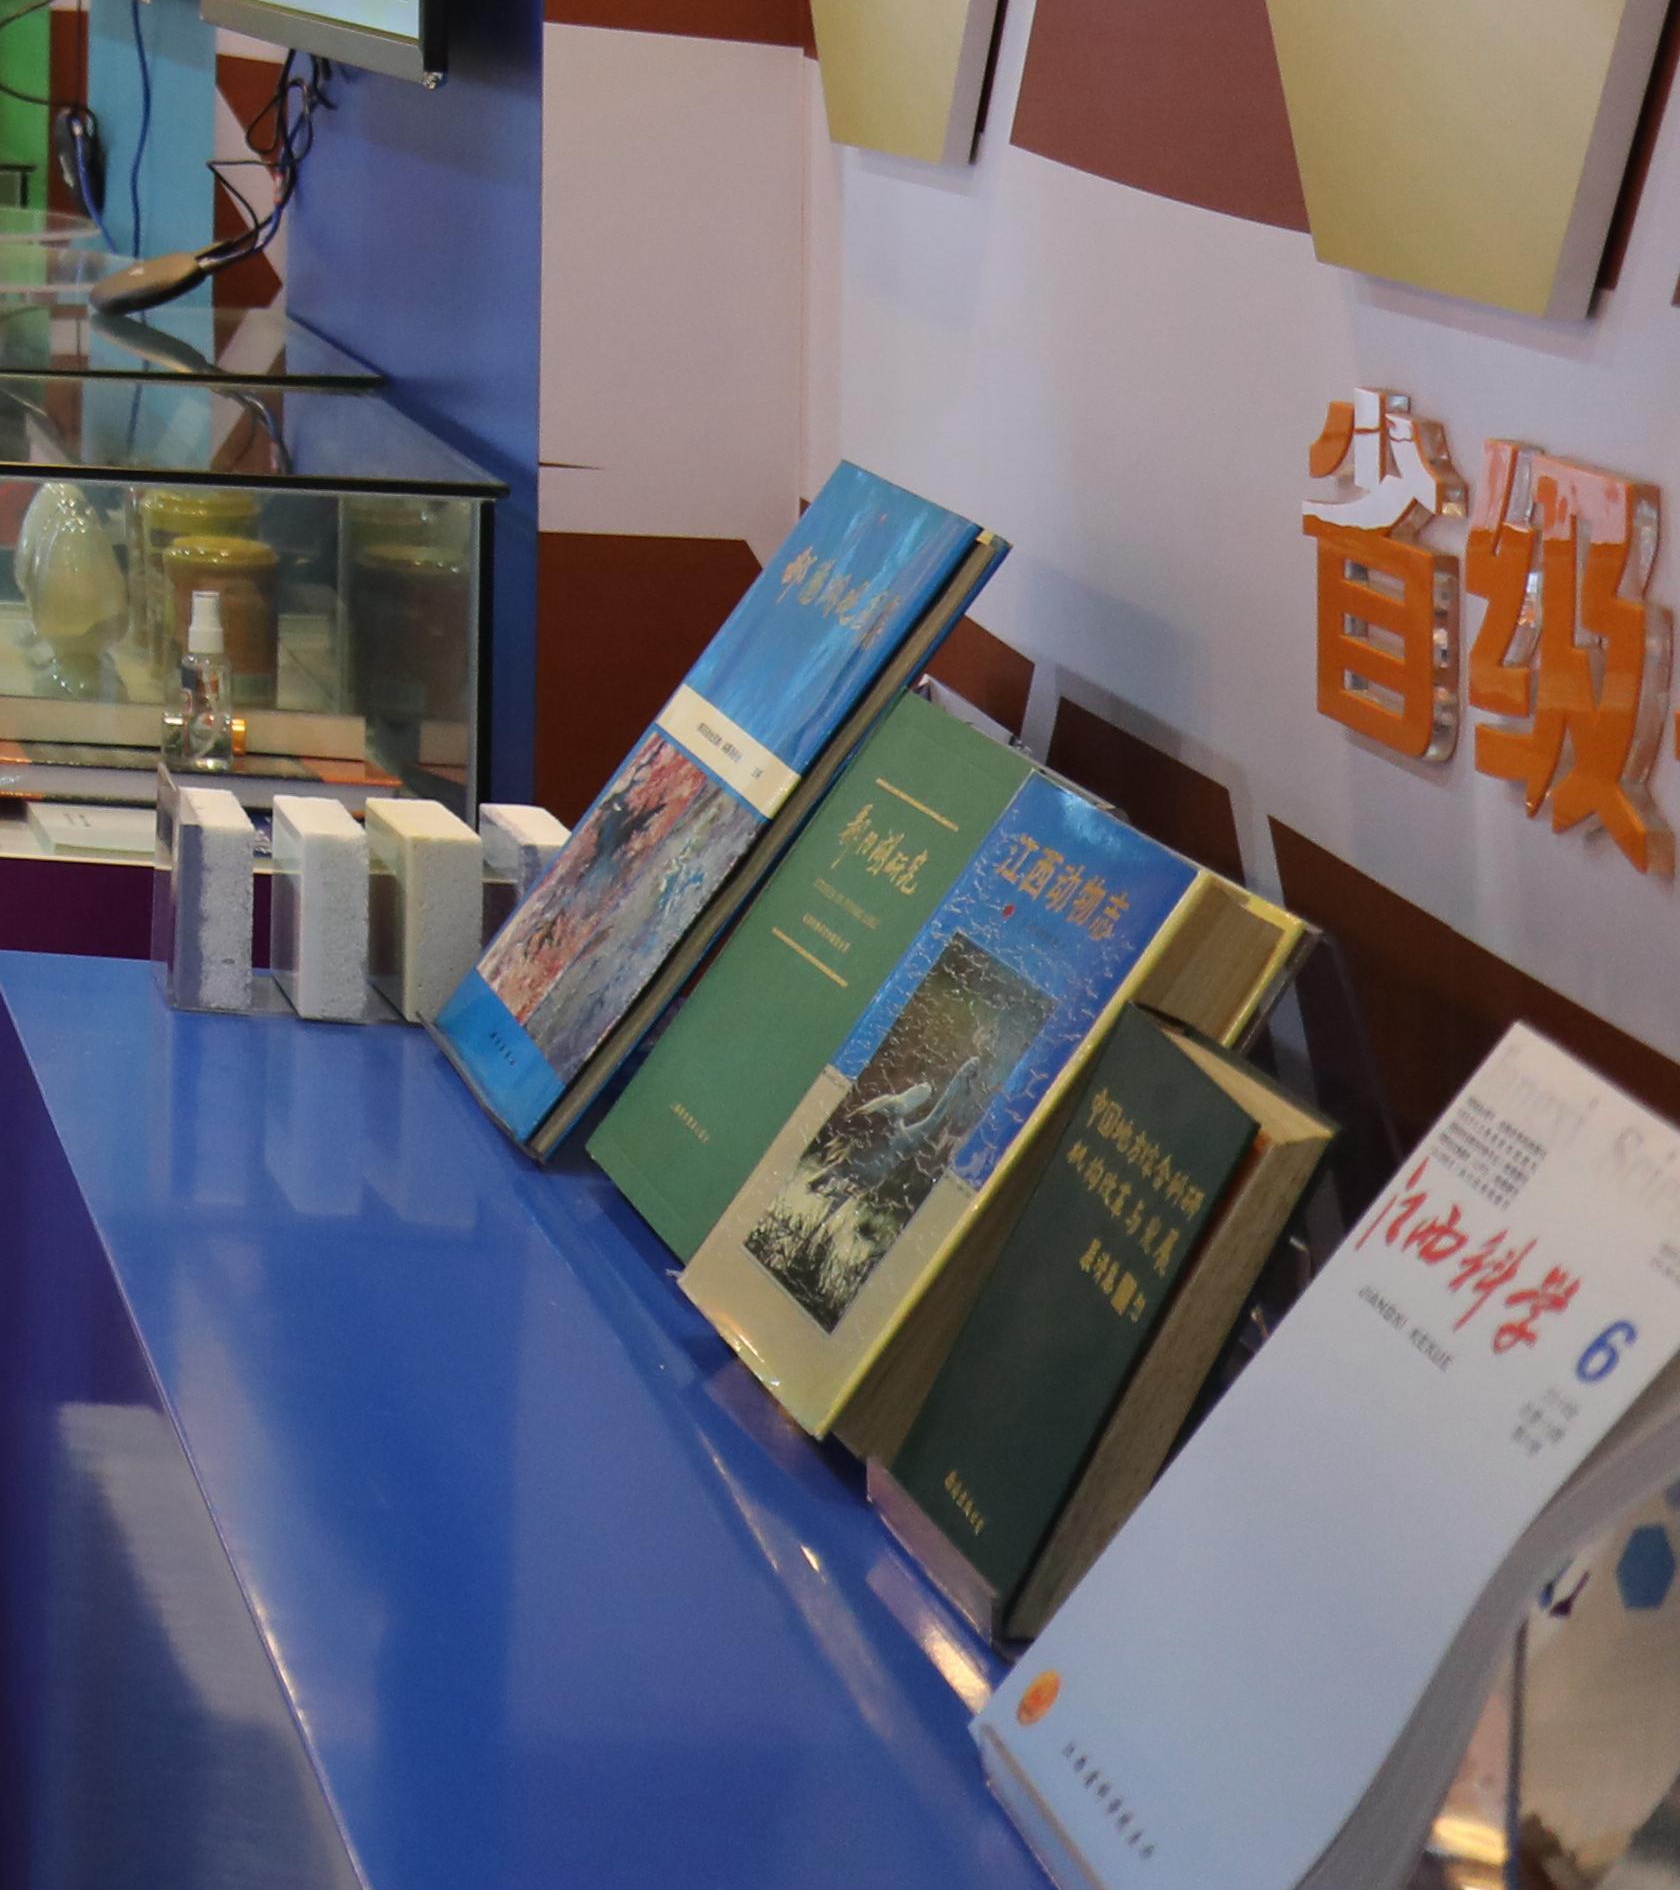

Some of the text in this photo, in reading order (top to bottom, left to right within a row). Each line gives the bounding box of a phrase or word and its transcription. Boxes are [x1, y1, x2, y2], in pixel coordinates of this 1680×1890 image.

[1301, 386, 1652, 877] 省级
[996, 833, 1131, 942] 江西动物志
[1574, 1318, 1639, 1385] 6
